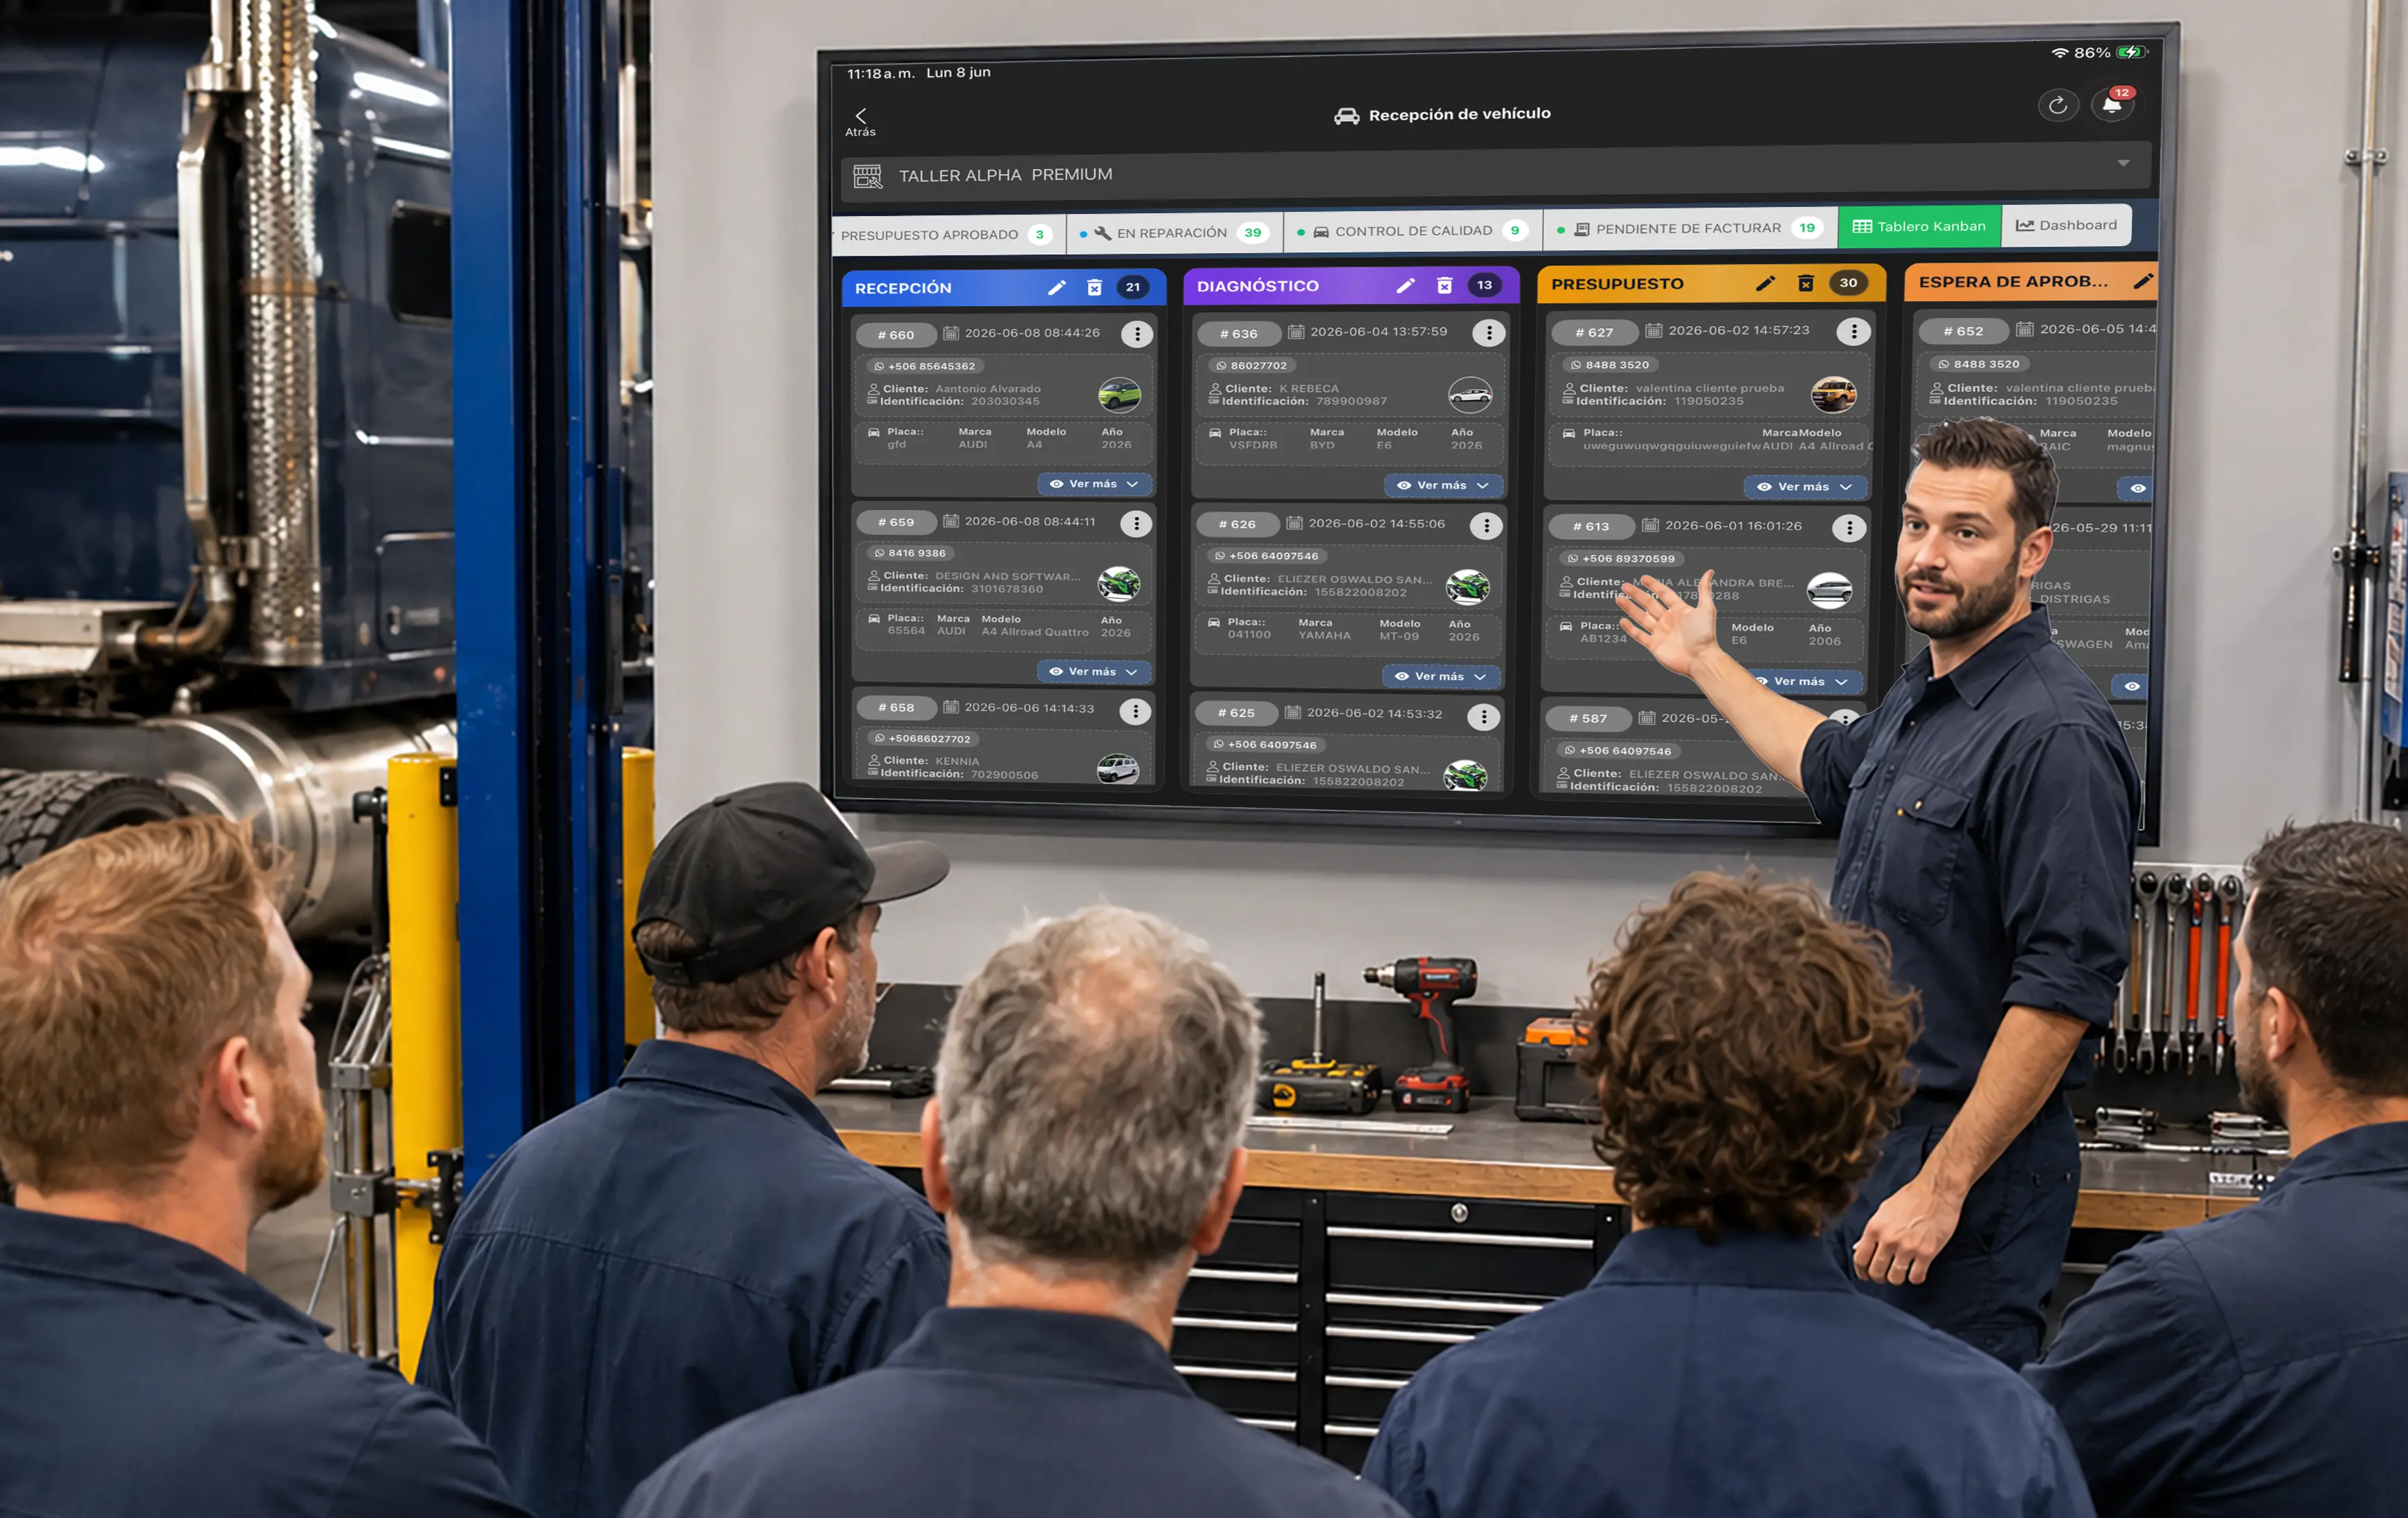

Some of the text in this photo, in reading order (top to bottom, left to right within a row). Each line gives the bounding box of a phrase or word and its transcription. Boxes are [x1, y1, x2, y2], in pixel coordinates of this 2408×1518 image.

[2074, 46, 2111, 59] 86%
[927, 66, 991, 80] Lun 8 jun
[2115, 88, 2129, 97] 12
[1370, 107, 1551, 123] Recepción de vehículo
[845, 127, 876, 137] Atrás
[898, 168, 1112, 183] TALLER ALPHA PREMIUM
[1597, 222, 1782, 235] PENDIENTE DE FACTURAR
[1799, 223, 1816, 233] 19
[1877, 220, 1986, 233] Tablero Kanban
[2040, 219, 2117, 231] Dashboard
[842, 229, 1019, 241] PRESUPUESTO APROBADO
[1035, 230, 1044, 240] 3
[1118, 225, 1227, 239] EN REPARACIÓN
[1244, 228, 1262, 237] 39
[1336, 225, 1493, 237] CONTROL DE CALIDAD
[1511, 226, 1520, 235] 9
[856, 279, 952, 294] RECEPCIÓN
[1126, 282, 1140, 292] 21
[1197, 277, 1319, 292] DIAGNÓSTICO
[1477, 280, 1492, 290] 13
[1552, 278, 1684, 290] PRESUPUESTO
[1840, 278, 1858, 288] 30
[1919, 275, 1991, 289] ESPERA
[1997, 275, 2021, 288] DE
[965, 327, 1101, 338] 2026-06-08 08:44:26
[1232, 329, 1258, 339] 636
[1311, 326, 1448, 337] 2026-06-04 13:57:59
[1588, 327, 1613, 338] 627
[1669, 325, 1810, 336] 2026-06-02 14:57:23
[1957, 326, 1984, 336] 652
[2040, 324, 2124, 334] 2026-06-05
[889, 330, 914, 340] 660
[888, 362, 975, 370] +506 85645362
[1231, 361, 1287, 370] 86027702
[1586, 361, 1649, 370] 8488 3520
[1954, 360, 2020, 369] 8488 3520
[883, 384, 1041, 393] Cliente: Aantonio Alvarado
[1225, 383, 1339, 393] Cliente: K REBECA
[1579, 383, 1784, 395] Cliente: valentina cliente prueba
[880, 396, 1040, 406] Identificación: 203030345
[1577, 396, 1744, 406] Identificación: 119050235
[1944, 396, 2118, 406] Identificación: 119050235
[887, 427, 924, 435] Placa::
[1026, 427, 1067, 436] Modelo
[1101, 427, 1123, 436] Año
[1229, 428, 1267, 436] Placa::
[1310, 428, 1345, 436] Marca
[1377, 428, 1418, 436] Modelo
[1451, 428, 1474, 437] Año
[2040, 429, 2076, 437] Marca
[2108, 428, 2152, 437] Modelo
[887, 440, 906, 450] gfd
[959, 440, 988, 449] AUDI
[1026, 440, 1042, 449] A4
[1102, 440, 1132, 449] 2026
[1229, 440, 1278, 449] VSFDRB
[1310, 441, 1335, 449] BYD
[1377, 441, 1392, 449] E6
[1451, 441, 1483, 450] 2026
[1069, 479, 1117, 488] Ver más
[889, 518, 914, 527] 659
[965, 516, 1095, 526] 2026-06-08 08:44:11
[1231, 520, 1256, 529] 626
[1309, 518, 1446, 529] 2026-06-02 14:55:06
[1665, 521, 1802, 531] 2026-06-01 16:01:26
[1586, 522, 1609, 532] 613
[2052, 523, 2118, 534] 26-05-29
[889, 549, 946, 557] 8416 9386
[1229, 552, 1319, 561] +506 64097546
[1583, 554, 1675, 563] +506 89370599
[883, 570, 928, 580] Cliente:
[936, 572, 980, 580] DESIGN
[983, 572, 1009, 580] AND
[1224, 574, 1271, 583] Cliente:
[1278, 575, 1327, 584] ELIEZER
[1330, 575, 1393, 584] OSWALDO
[880, 583, 1043, 593] Identificación: 3101678360
[2040, 595, 2110, 604] DISTRIGAS
[888, 614, 924, 622] Placa::
[937, 615, 970, 623] Marca
[981, 615, 1022, 624] Modelo
[1101, 616, 1123, 624] Año
[887, 626, 925, 635] 65564
[937, 626, 966, 635] AUDI
[981, 627, 1089, 637] A4 Allroad Quattro
[1101, 628, 1131, 638] 2026
[1580, 633, 1627, 644] AB1234
[1415, 671, 1465, 681] Ver más
[1774, 676, 1825, 686] Ver más
[890, 703, 914, 712] 658
[965, 703, 1094, 714] 2026-06-06 14:14:33
[1230, 708, 1255, 718] 625
[1307, 707, 1442, 719] 2026-06-02 14:53:32
[1582, 714, 1607, 723] 587
[889, 734, 970, 743] +50686027702
[884, 755, 980, 766] Cliente: KENNIA
